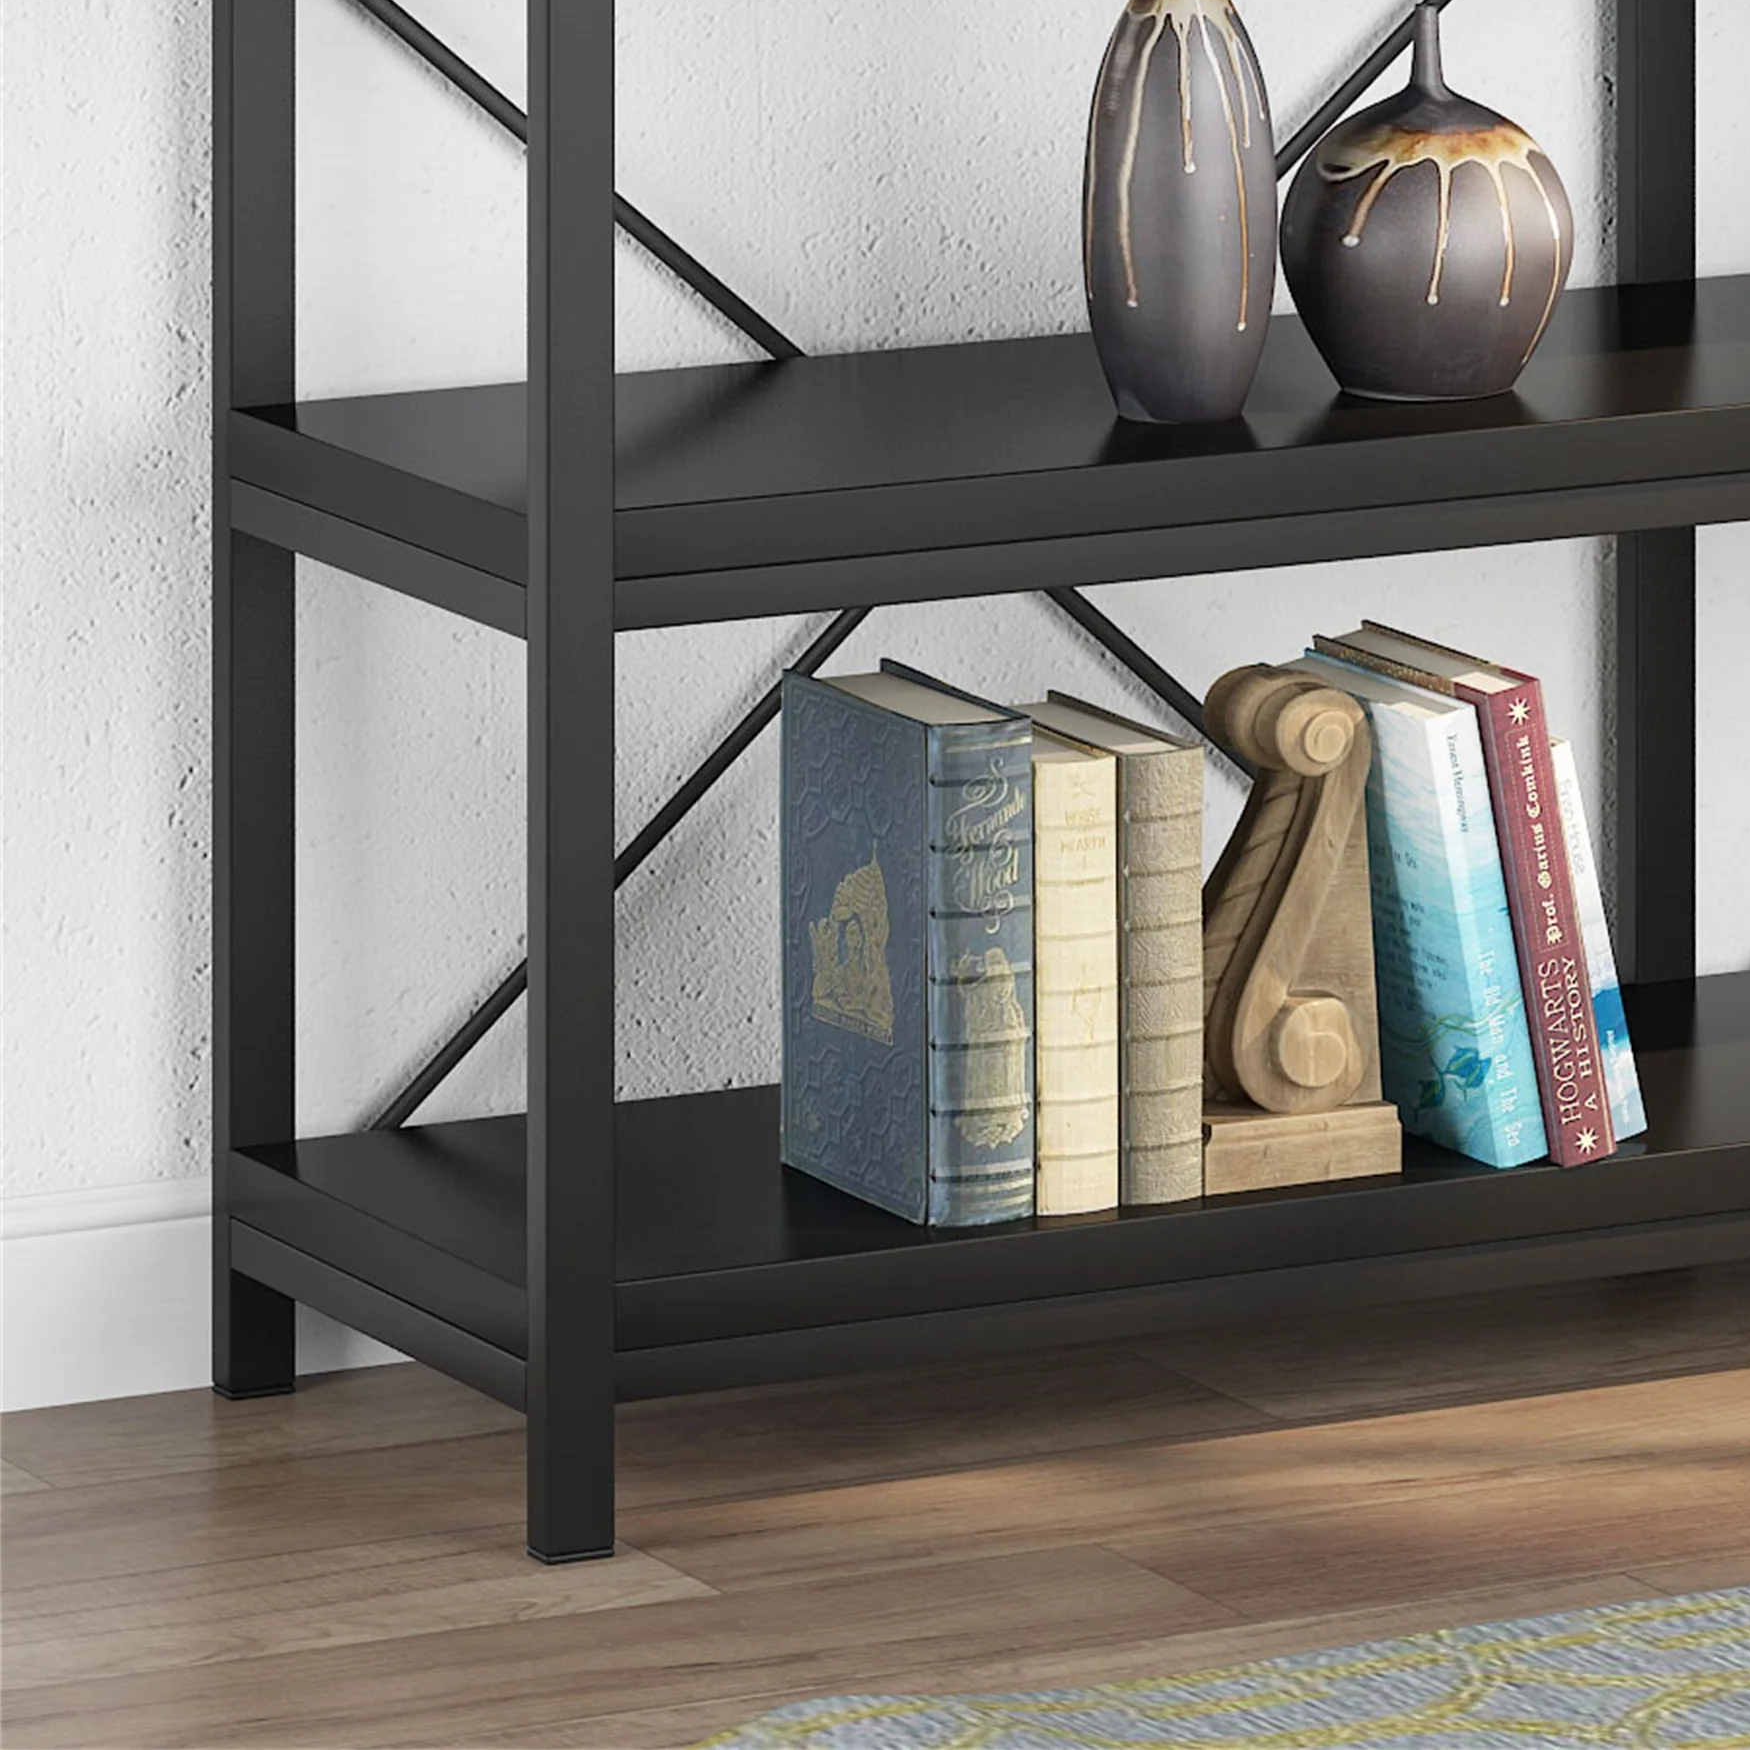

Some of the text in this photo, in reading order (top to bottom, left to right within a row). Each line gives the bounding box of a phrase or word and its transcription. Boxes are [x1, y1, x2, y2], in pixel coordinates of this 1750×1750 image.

[1477, 950, 1494, 975] The
[1537, 957, 1583, 1126] HOGWARTS
[1560, 957, 1599, 1111] A HISTORY
[1495, 1053, 1513, 1081] and
[1501, 1086, 1518, 1113] The
[1504, 1121, 1522, 1147] Sea
